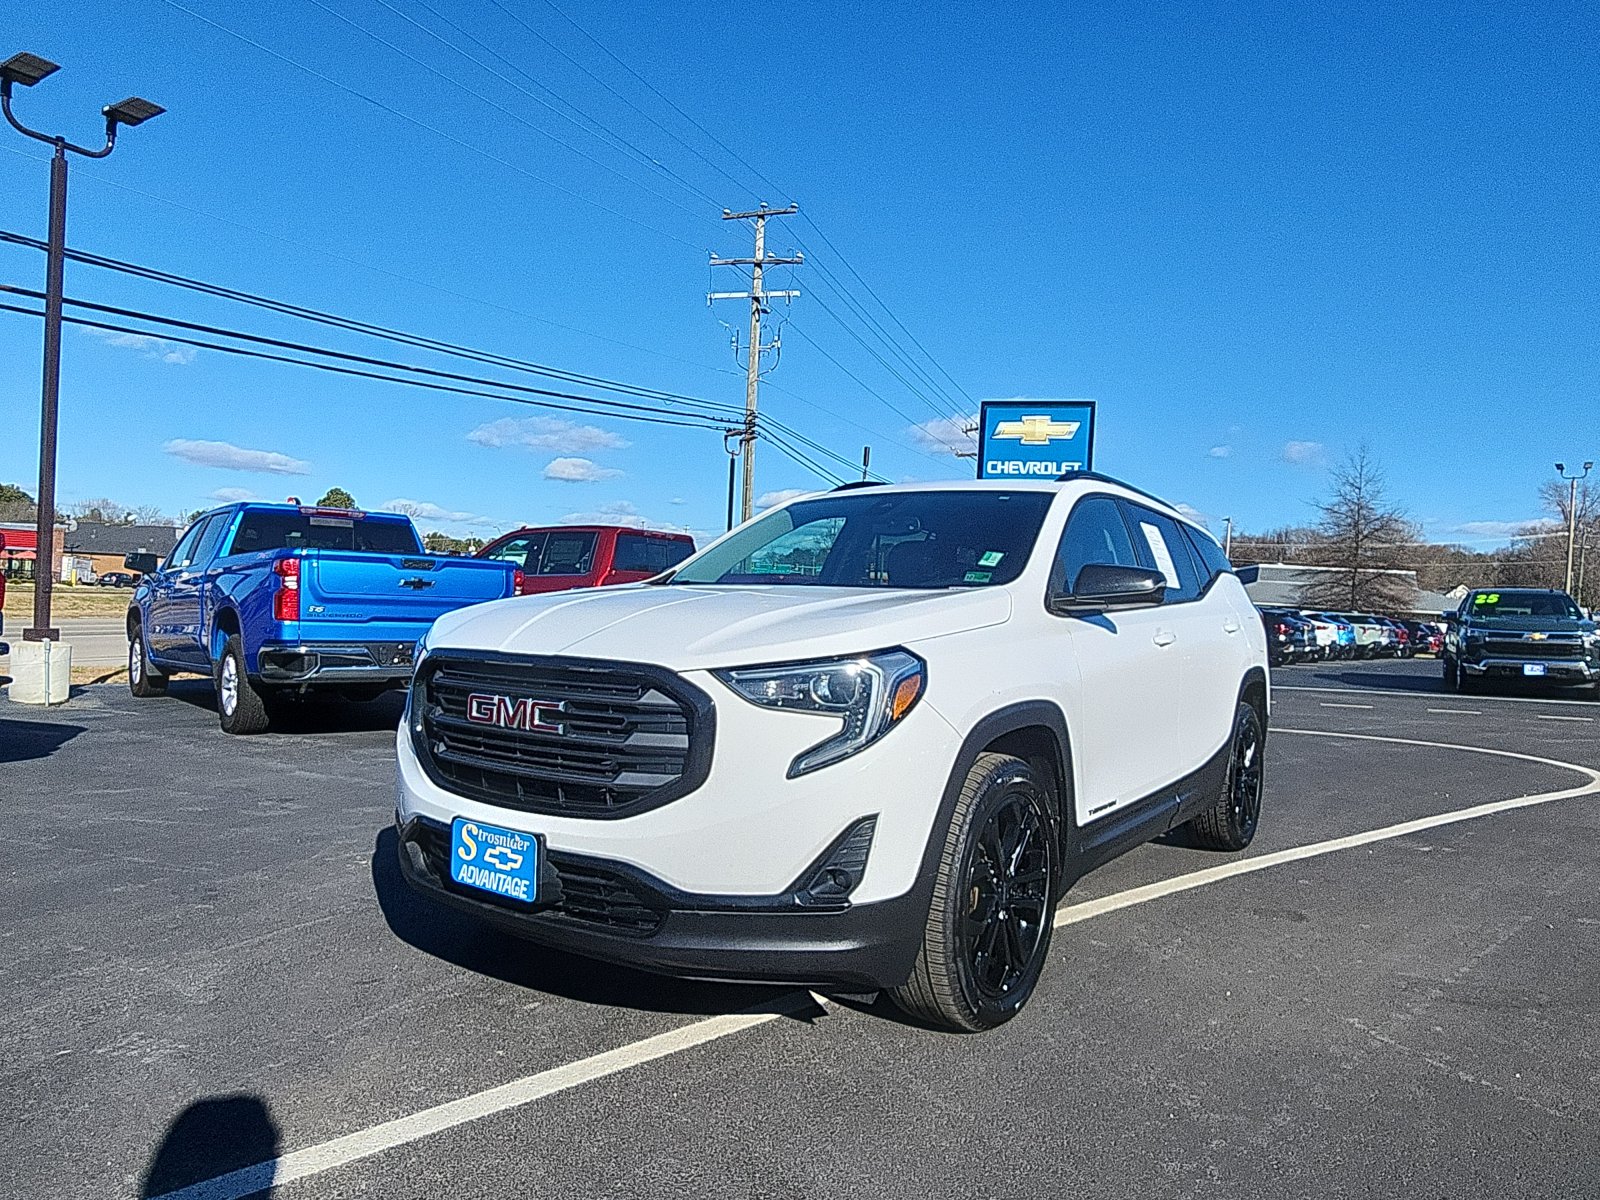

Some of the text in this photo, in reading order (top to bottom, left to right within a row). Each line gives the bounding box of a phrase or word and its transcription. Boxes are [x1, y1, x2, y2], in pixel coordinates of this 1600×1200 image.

[986, 460, 1082, 475] CHEVROLET
[1474, 593, 1500, 605] 25
[467, 693, 565, 734] GMC
[458, 823, 531, 861] Strosnider
[458, 863, 530, 899] ADVANTAGE
